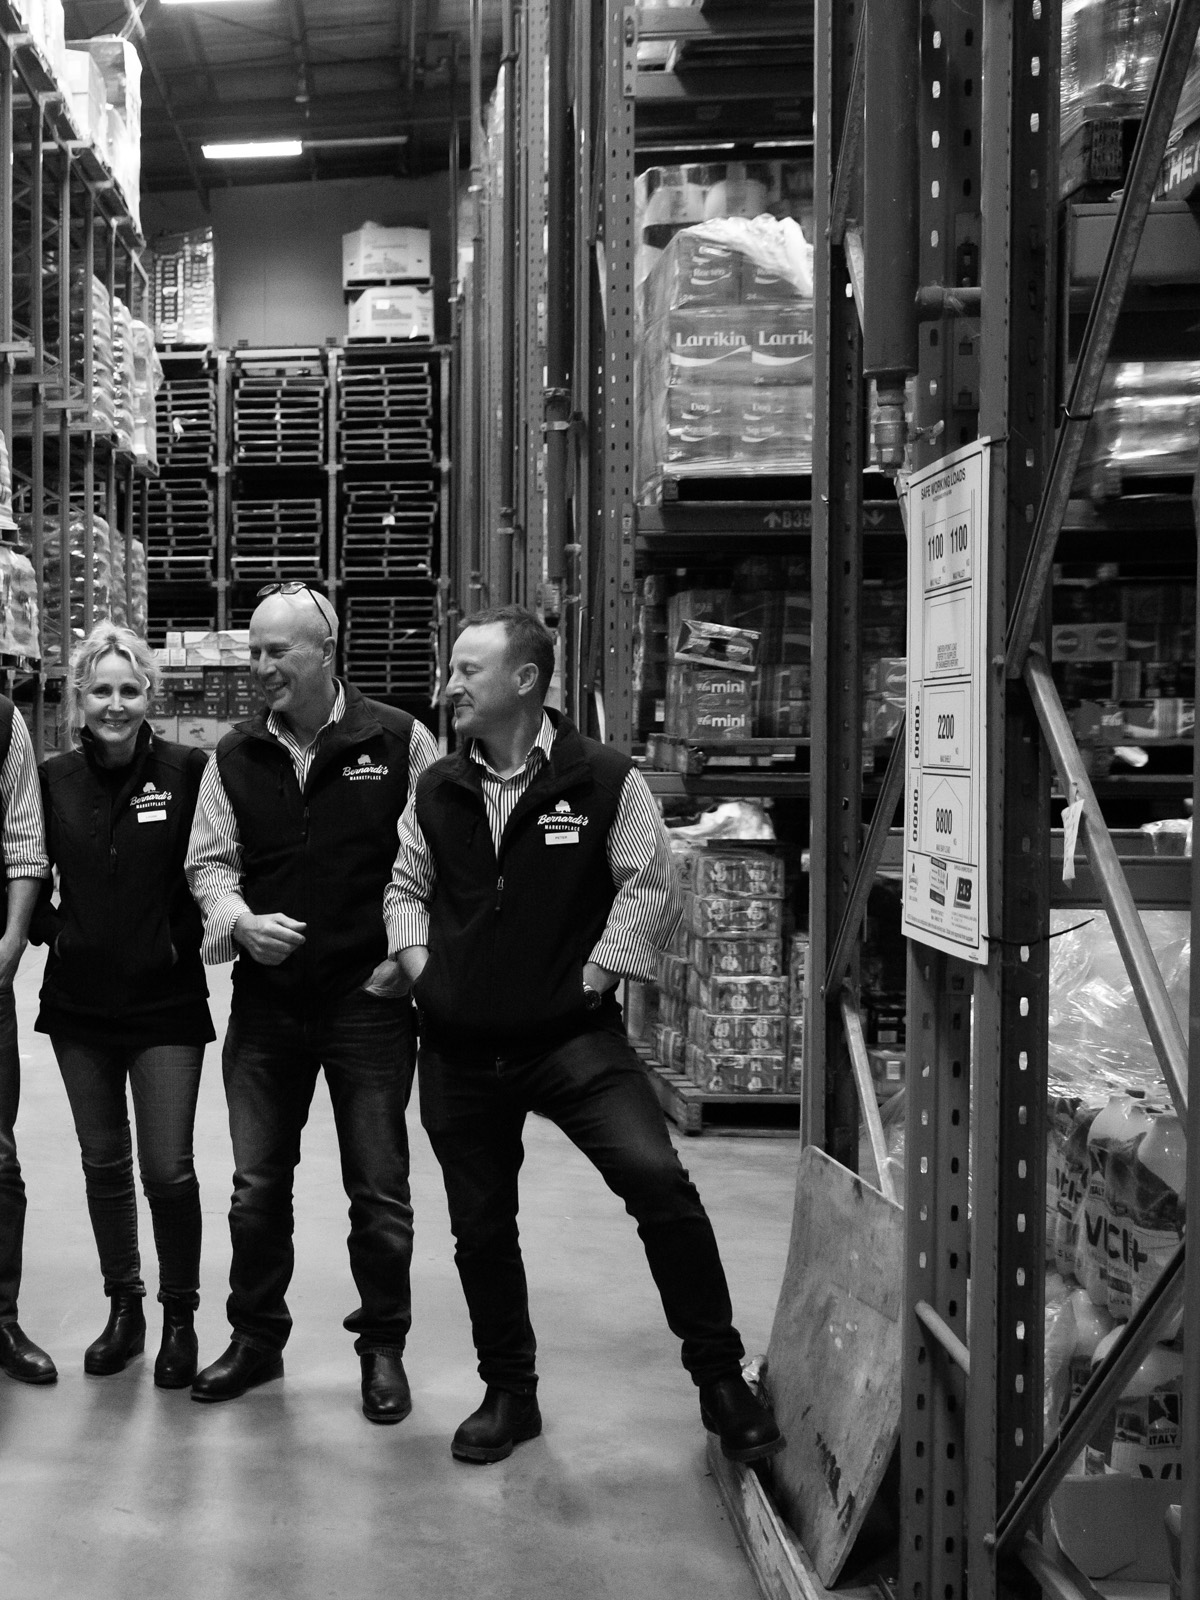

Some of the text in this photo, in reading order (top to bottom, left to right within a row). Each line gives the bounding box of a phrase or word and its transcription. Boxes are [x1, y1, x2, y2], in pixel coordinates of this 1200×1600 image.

[675, 332, 747, 347] Larrikin
[921, 485, 931, 500] SAFE
[950, 467, 966, 486] LOADS
[928, 524, 968, 562] 1100 1100
[711, 680, 745, 693] mini
[711, 714, 745, 727] mini
[938, 714, 954, 739] 2200
[342, 764, 389, 777] Bernardi's
[129, 790, 172, 806] Bernardi's
[135, 801, 166, 809] MARKETPLACE
[537, 814, 589, 826] Bernardi's
[936, 808, 952, 835] 8800
[544, 824, 580, 832] MARKETPLACE
[1149, 1434, 1177, 1446] ITALY
